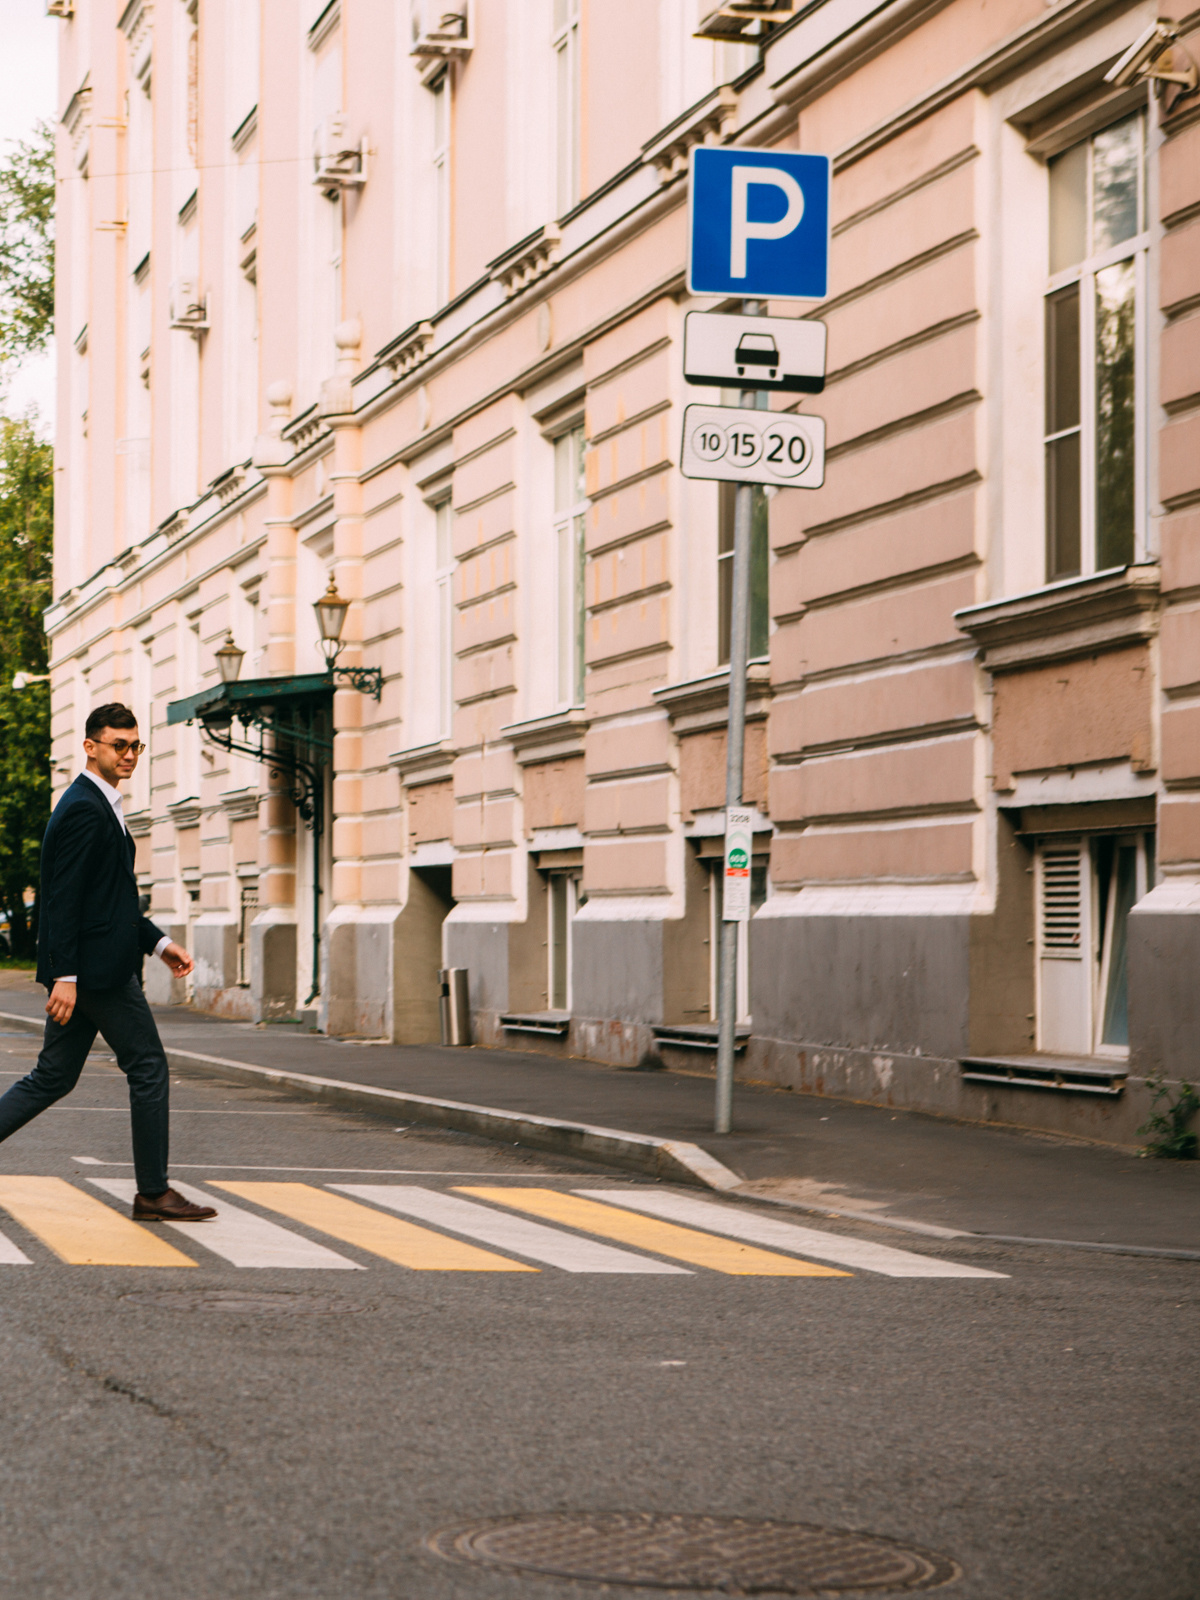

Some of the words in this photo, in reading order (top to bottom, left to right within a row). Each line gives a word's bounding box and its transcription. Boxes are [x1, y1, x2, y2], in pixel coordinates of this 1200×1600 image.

[730, 165, 805, 279] P
[701, 432, 721, 452] 10
[731, 433, 756, 457] 15
[767, 434, 806, 464] 20
